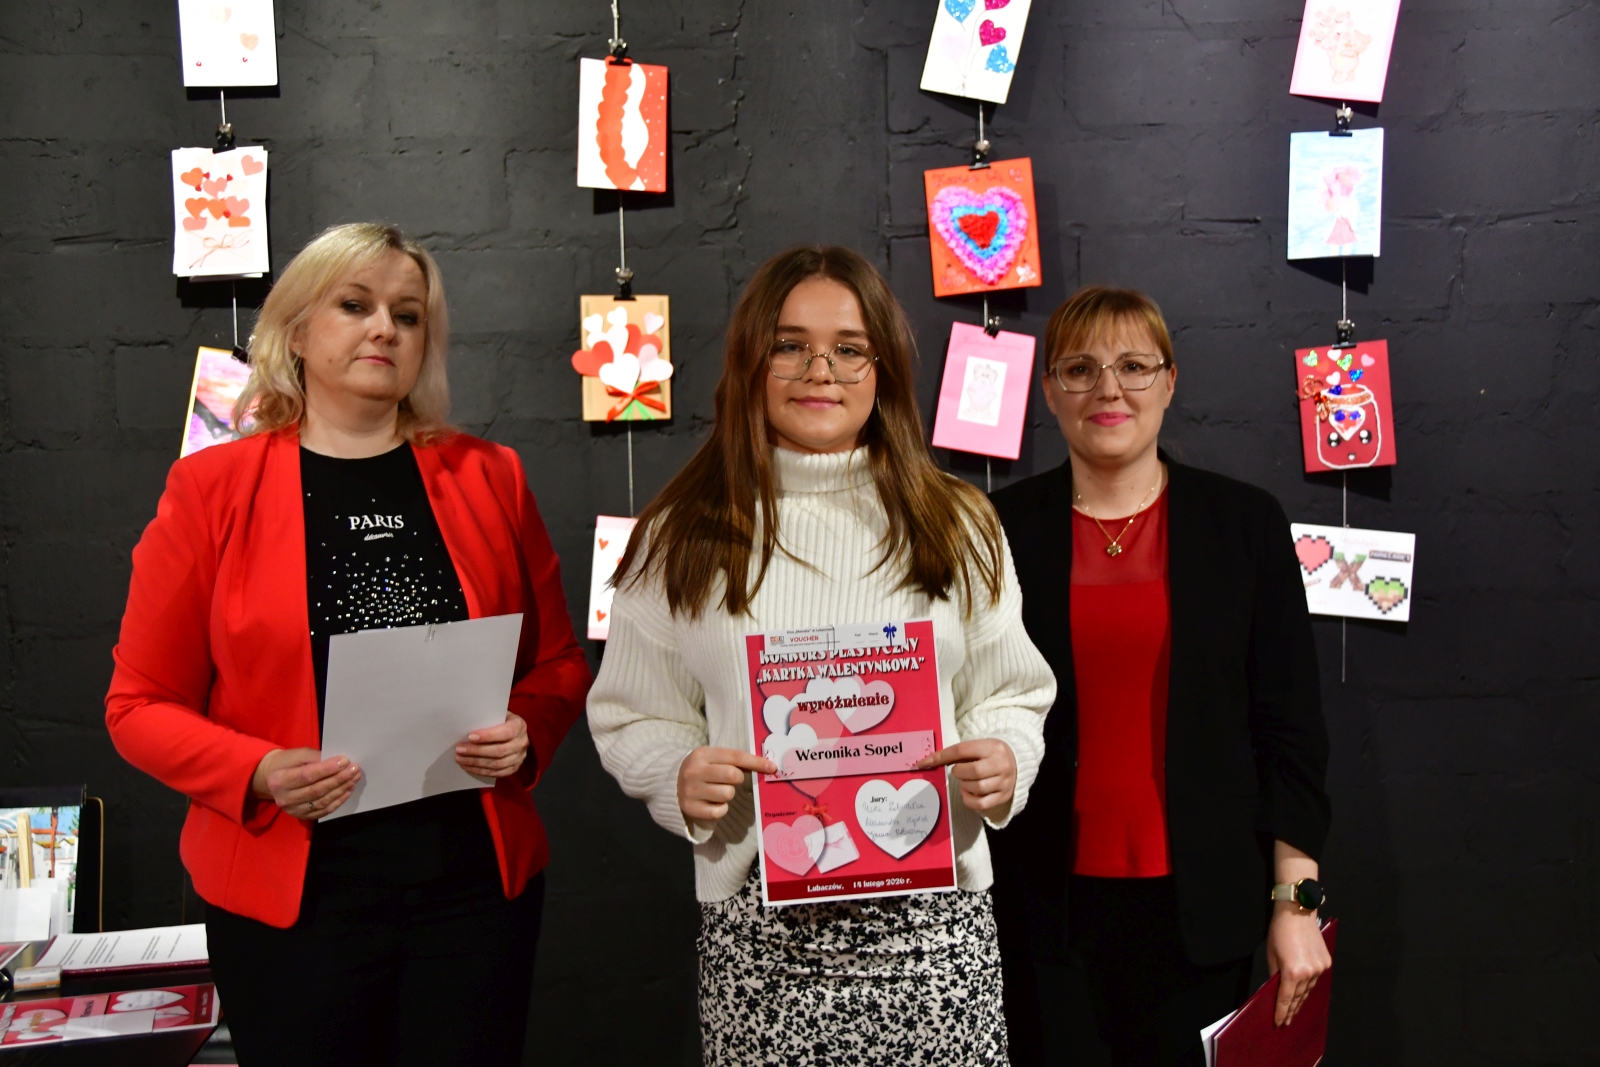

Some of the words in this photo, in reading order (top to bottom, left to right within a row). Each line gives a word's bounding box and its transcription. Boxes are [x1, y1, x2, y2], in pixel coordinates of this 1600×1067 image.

[348, 514, 404, 530] PARIS
[797, 692, 890, 714] wyróżnienie
[795, 746, 860, 761] Weronika
[864, 742, 903, 757] Sopel
[863, 879, 884, 888] lutego
[886, 877, 905, 886] 2026
